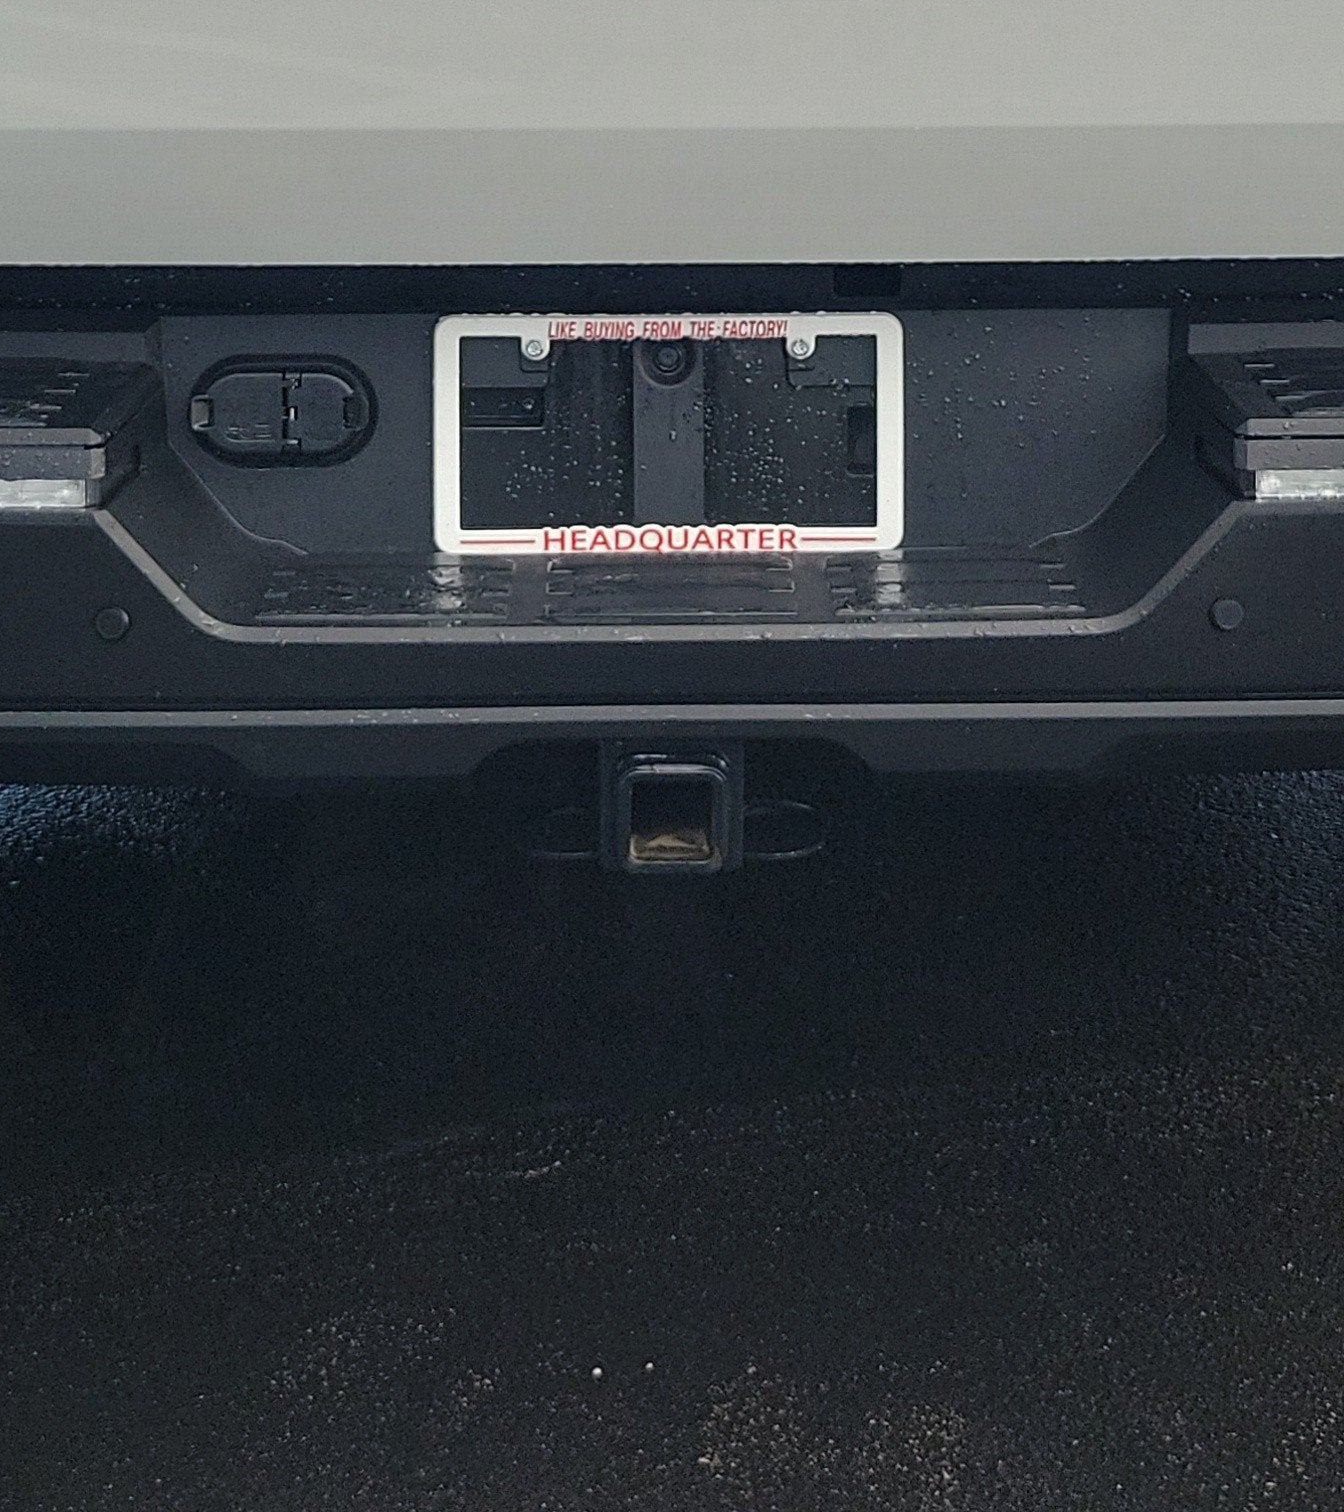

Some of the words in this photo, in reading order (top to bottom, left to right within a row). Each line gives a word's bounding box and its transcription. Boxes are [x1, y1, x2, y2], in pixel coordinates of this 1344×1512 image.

[547, 320, 576, 338] LIKE
[583, 320, 635, 338] BUYING
[642, 320, 682, 338] FROM
[689, 320, 715, 337] THE
[722, 319, 789, 337] FACTORY!
[543, 528, 798, 554] HEADQUARTER
